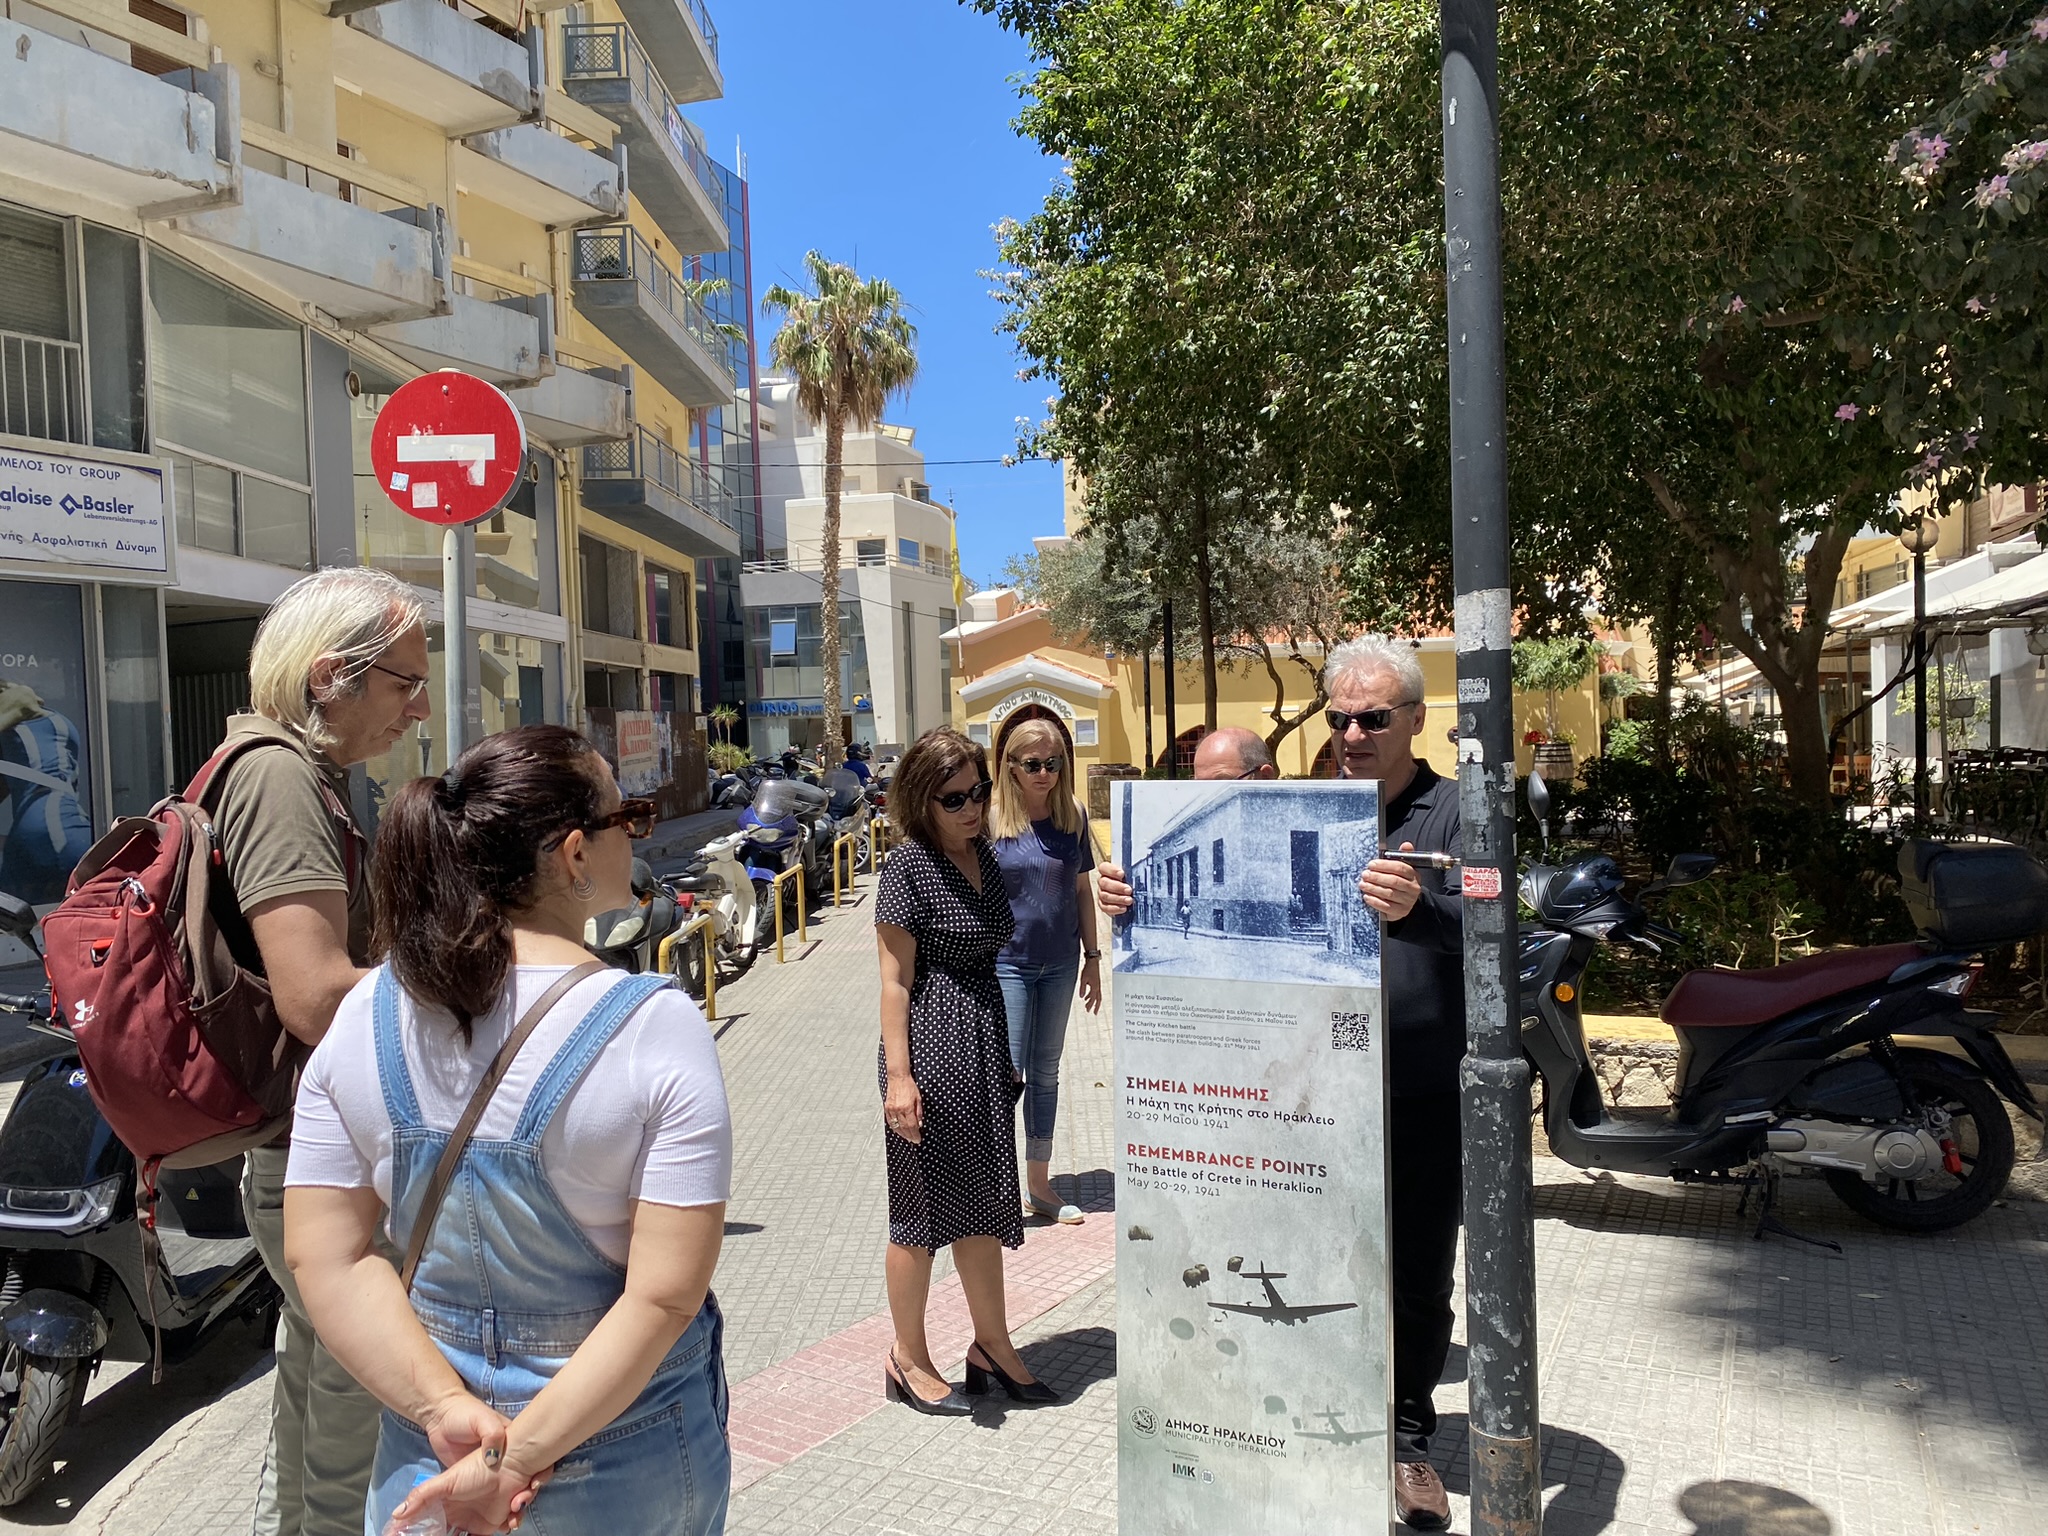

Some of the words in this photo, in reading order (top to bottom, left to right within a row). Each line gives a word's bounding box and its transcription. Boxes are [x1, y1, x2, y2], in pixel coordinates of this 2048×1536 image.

[0, 457, 43, 471] ΜΕΛΟΣ
[50, 463, 73, 475] ΤΟΥ
[80, 467, 121, 481] GROUP
[0, 486, 52, 506] aloise
[83, 495, 134, 514] Basler
[0, 530, 23, 544] νής
[32, 533, 108, 549] Ασφαλιστική
[116, 540, 157, 555] Δύναμη
[0, 653, 39, 668] ΟΡΑ
[1176, 1033, 1212, 1041] paratroopers
[1126, 1076, 1188, 1094] ΣΗΜΕΙΑ
[1193, 1084, 1269, 1102] ΜΝΗΜΗΣ
[1127, 1096, 1134, 1105] Η
[1139, 1097, 1170, 1111] Μάχη
[1174, 1102, 1194, 1113] της
[1198, 1102, 1243, 1118] Κρήτης
[1247, 1110, 1269, 1119] στο
[1274, 1111, 1335, 1128] Ηράκλειο
[1127, 1111, 1159, 1123] 20-29
[1163, 1113, 1199, 1126] Μαΐου
[1203, 1119, 1229, 1129] 1941
[1127, 1143, 1255, 1170] REMEMBRANCE
[1262, 1158, 1328, 1178] POINTS
[1127, 1163, 1148, 1174] The
[1152, 1165, 1187, 1179] Battle
[1191, 1170, 1204, 1181] of
[1208, 1172, 1242, 1186] Crete
[1246, 1175, 1257, 1187] in
[1262, 1178, 1322, 1195] Heraklion
[1127, 1177, 1149, 1190] May
[1154, 1180, 1190, 1195] 20-29,
[1195, 1186, 1221, 1197] 1941
[1165, 1418, 1209, 1435] ΔΗΜΟΣ
[1213, 1426, 1286, 1449] ΗΡΑΚΛΕΙΟΥ
[1165, 1430, 1222, 1446] MUNICIPALITY
[1224, 1440, 1236, 1449] OF
[1238, 1443, 1287, 1459] HERAKLION
[1173, 1463, 1195, 1478] IMK
